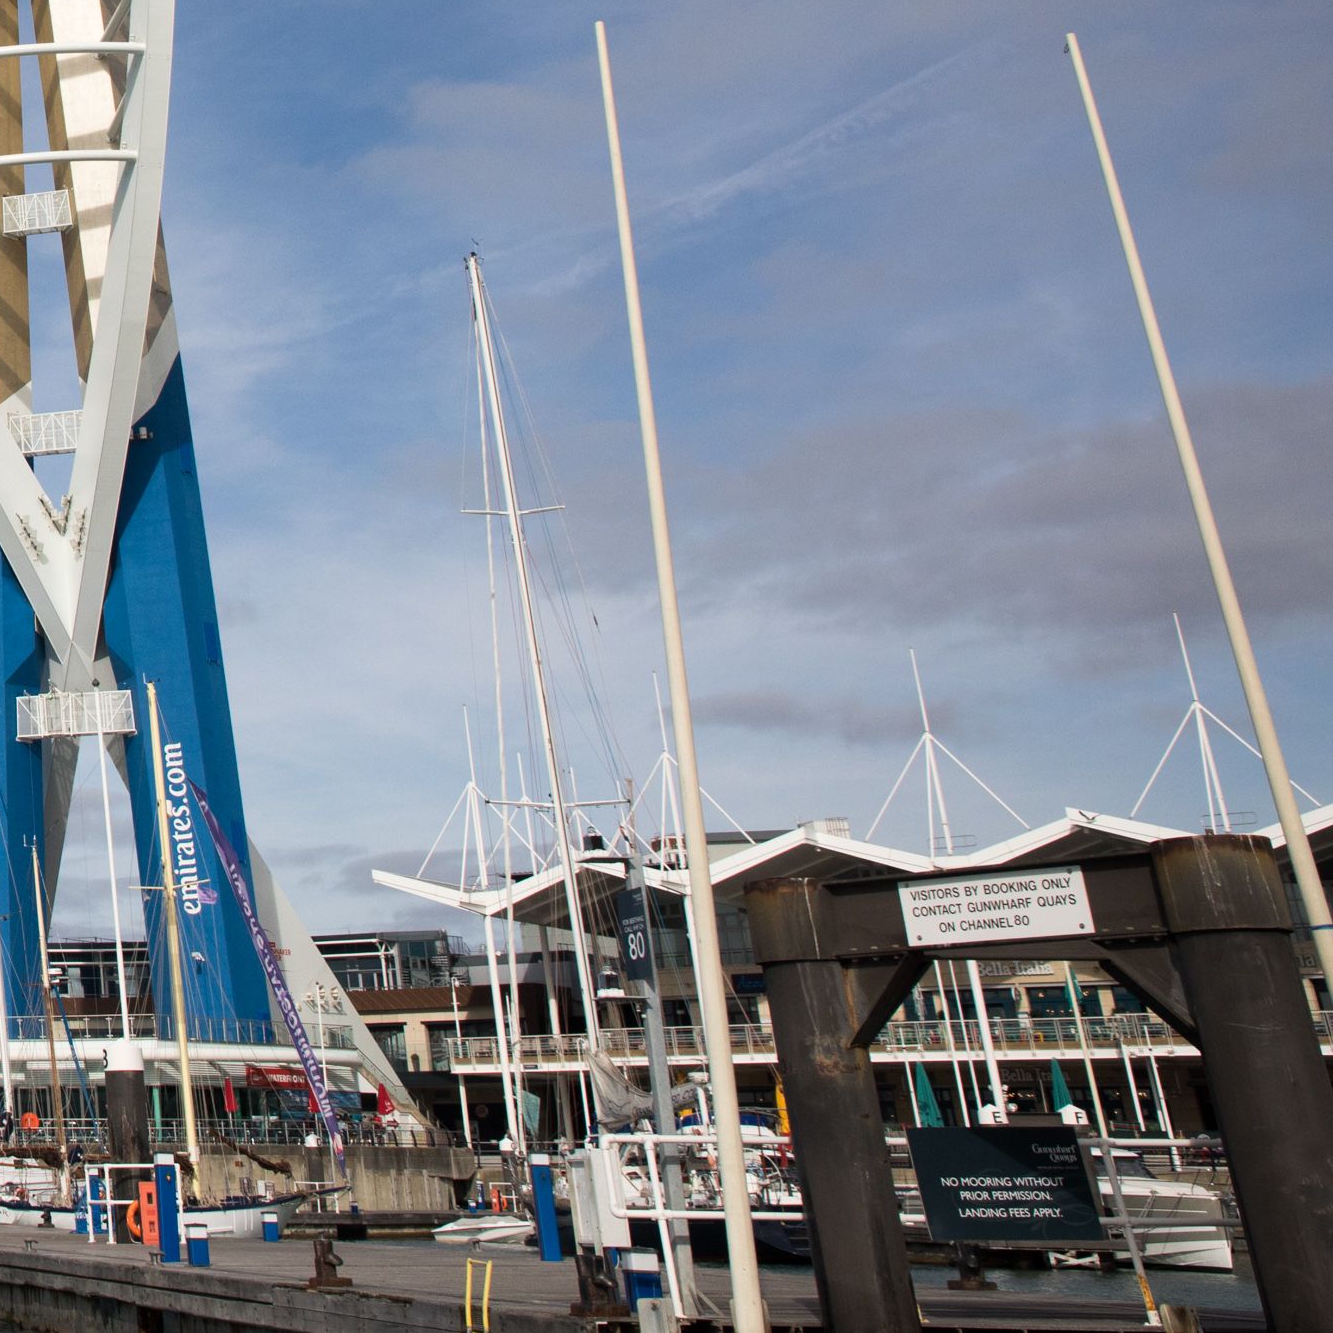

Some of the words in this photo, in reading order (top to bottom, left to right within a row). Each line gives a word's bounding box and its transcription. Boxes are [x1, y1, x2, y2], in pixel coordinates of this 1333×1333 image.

[164, 742, 201, 914] emirates.com
[910, 887, 960, 901] VISITORS
[965, 885, 978, 897] BY
[983, 880, 1037, 895] BOOKING
[1041, 877, 1071, 890] ONLY
[912, 903, 962, 917] CONTACT
[967, 898, 1032, 913] GUNWHARF
[1037, 893, 1077, 907] QUAYS
[939, 922, 956, 933] ON
[960, 917, 1013, 931] CHANNEL
[1014, 915, 1030, 926] 80
[628, 931, 645, 960] 80
[977, 962, 1011, 976] Bella
[1012, 961, 1054, 976] Italia
[1001, 1068, 1033, 1082] Bella
[993, 1112, 1003, 1123] E
[1075, 1112, 1084, 1124] F
[1031, 1143, 1076, 1154] Gunwharf
[1050, 1153, 1077, 1163] Quays
[940, 1177, 958, 1187] NO
[960, 1177, 1012, 1187] MOORING
[1013, 1177, 1064, 1187] WITHOUT
[960, 1191, 991, 1201] PRIOR
[992, 1191, 1053, 1201] PERMISSION.
[959, 1208, 1007, 1217] LANDING
[1009, 1208, 1031, 1217] FEES
[1032, 1208, 1063, 1218] APPLY.
